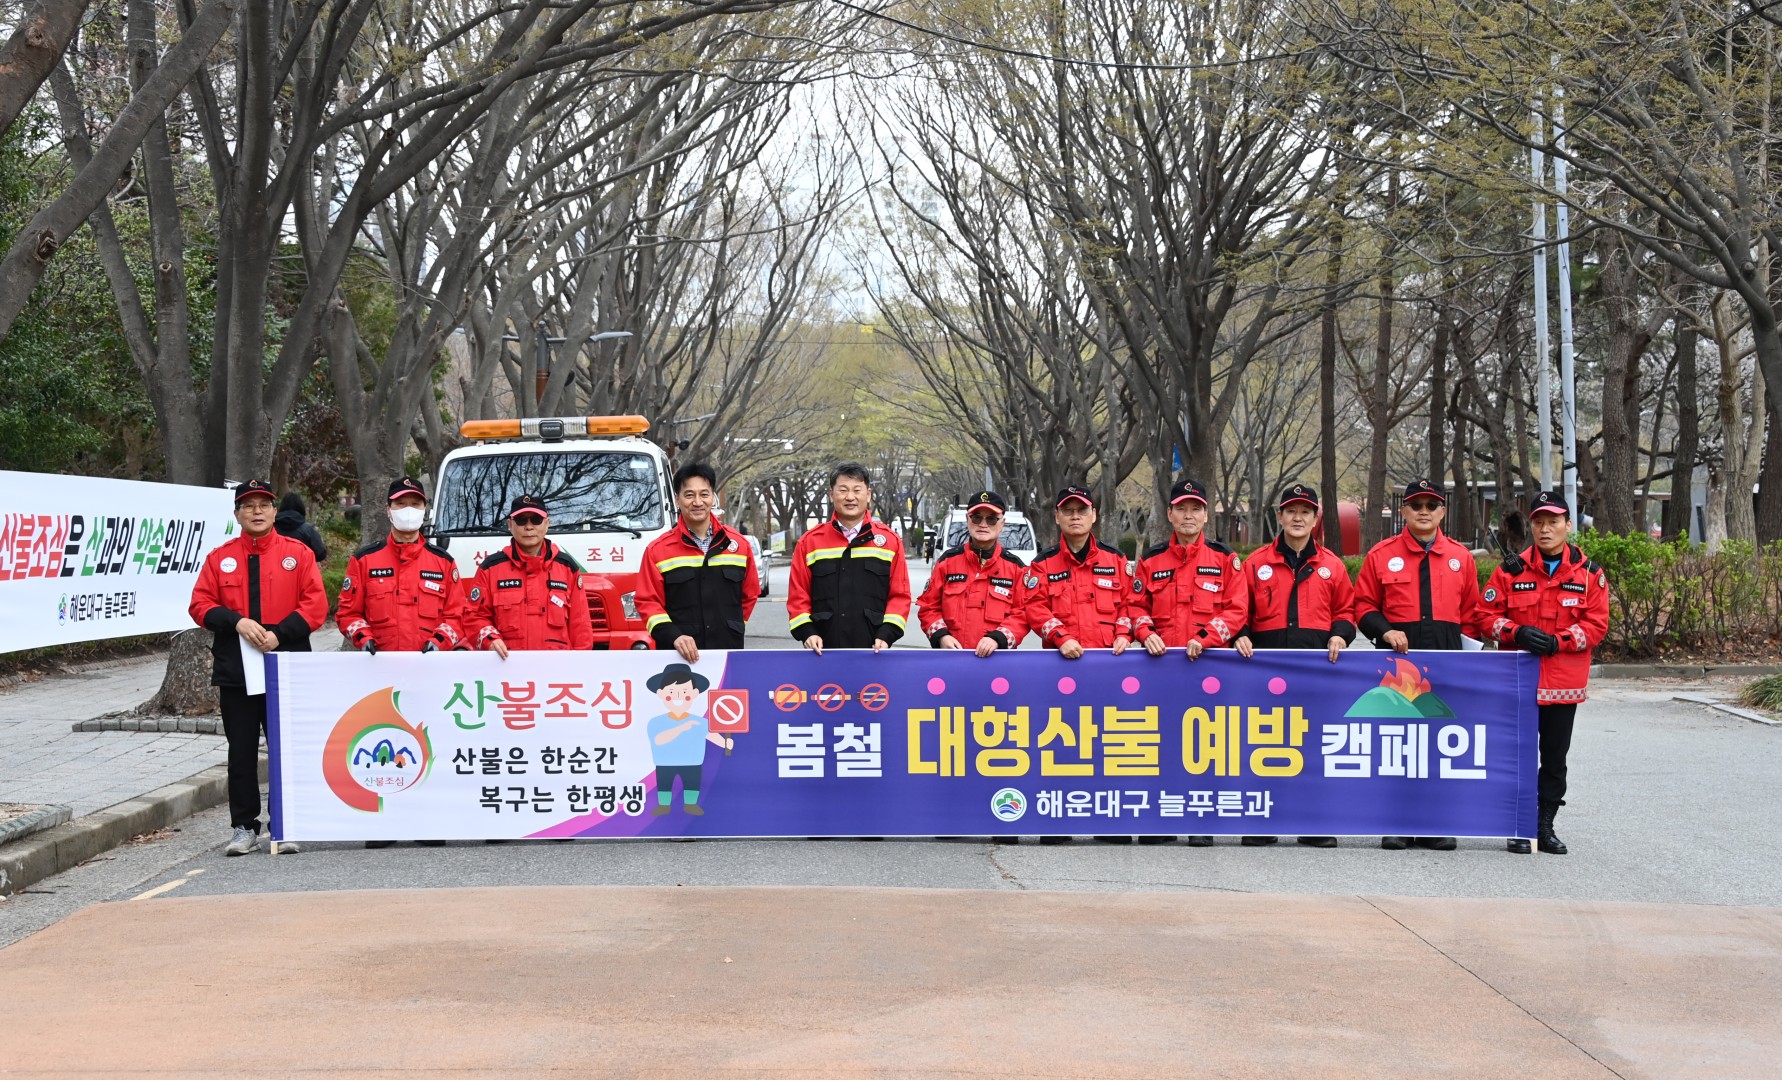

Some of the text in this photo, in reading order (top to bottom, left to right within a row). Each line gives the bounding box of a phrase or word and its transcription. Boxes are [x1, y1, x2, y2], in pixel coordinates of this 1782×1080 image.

[0, 513, 205, 580] 산불조심은 산과의 약속입니다.
[70, 591, 136, 622] 해운대구 늘푸른과
[443, 679, 632, 730] 산불조심
[776, 705, 1487, 780] 봄철 대형산불 예방 캠페인
[452, 745, 618, 775] 산불은 한순간
[364, 776, 405, 787] 산불조심
[479, 784, 643, 814] 복구는 한평생
[1036, 789, 1274, 818] 해운대구 늘푸른과
